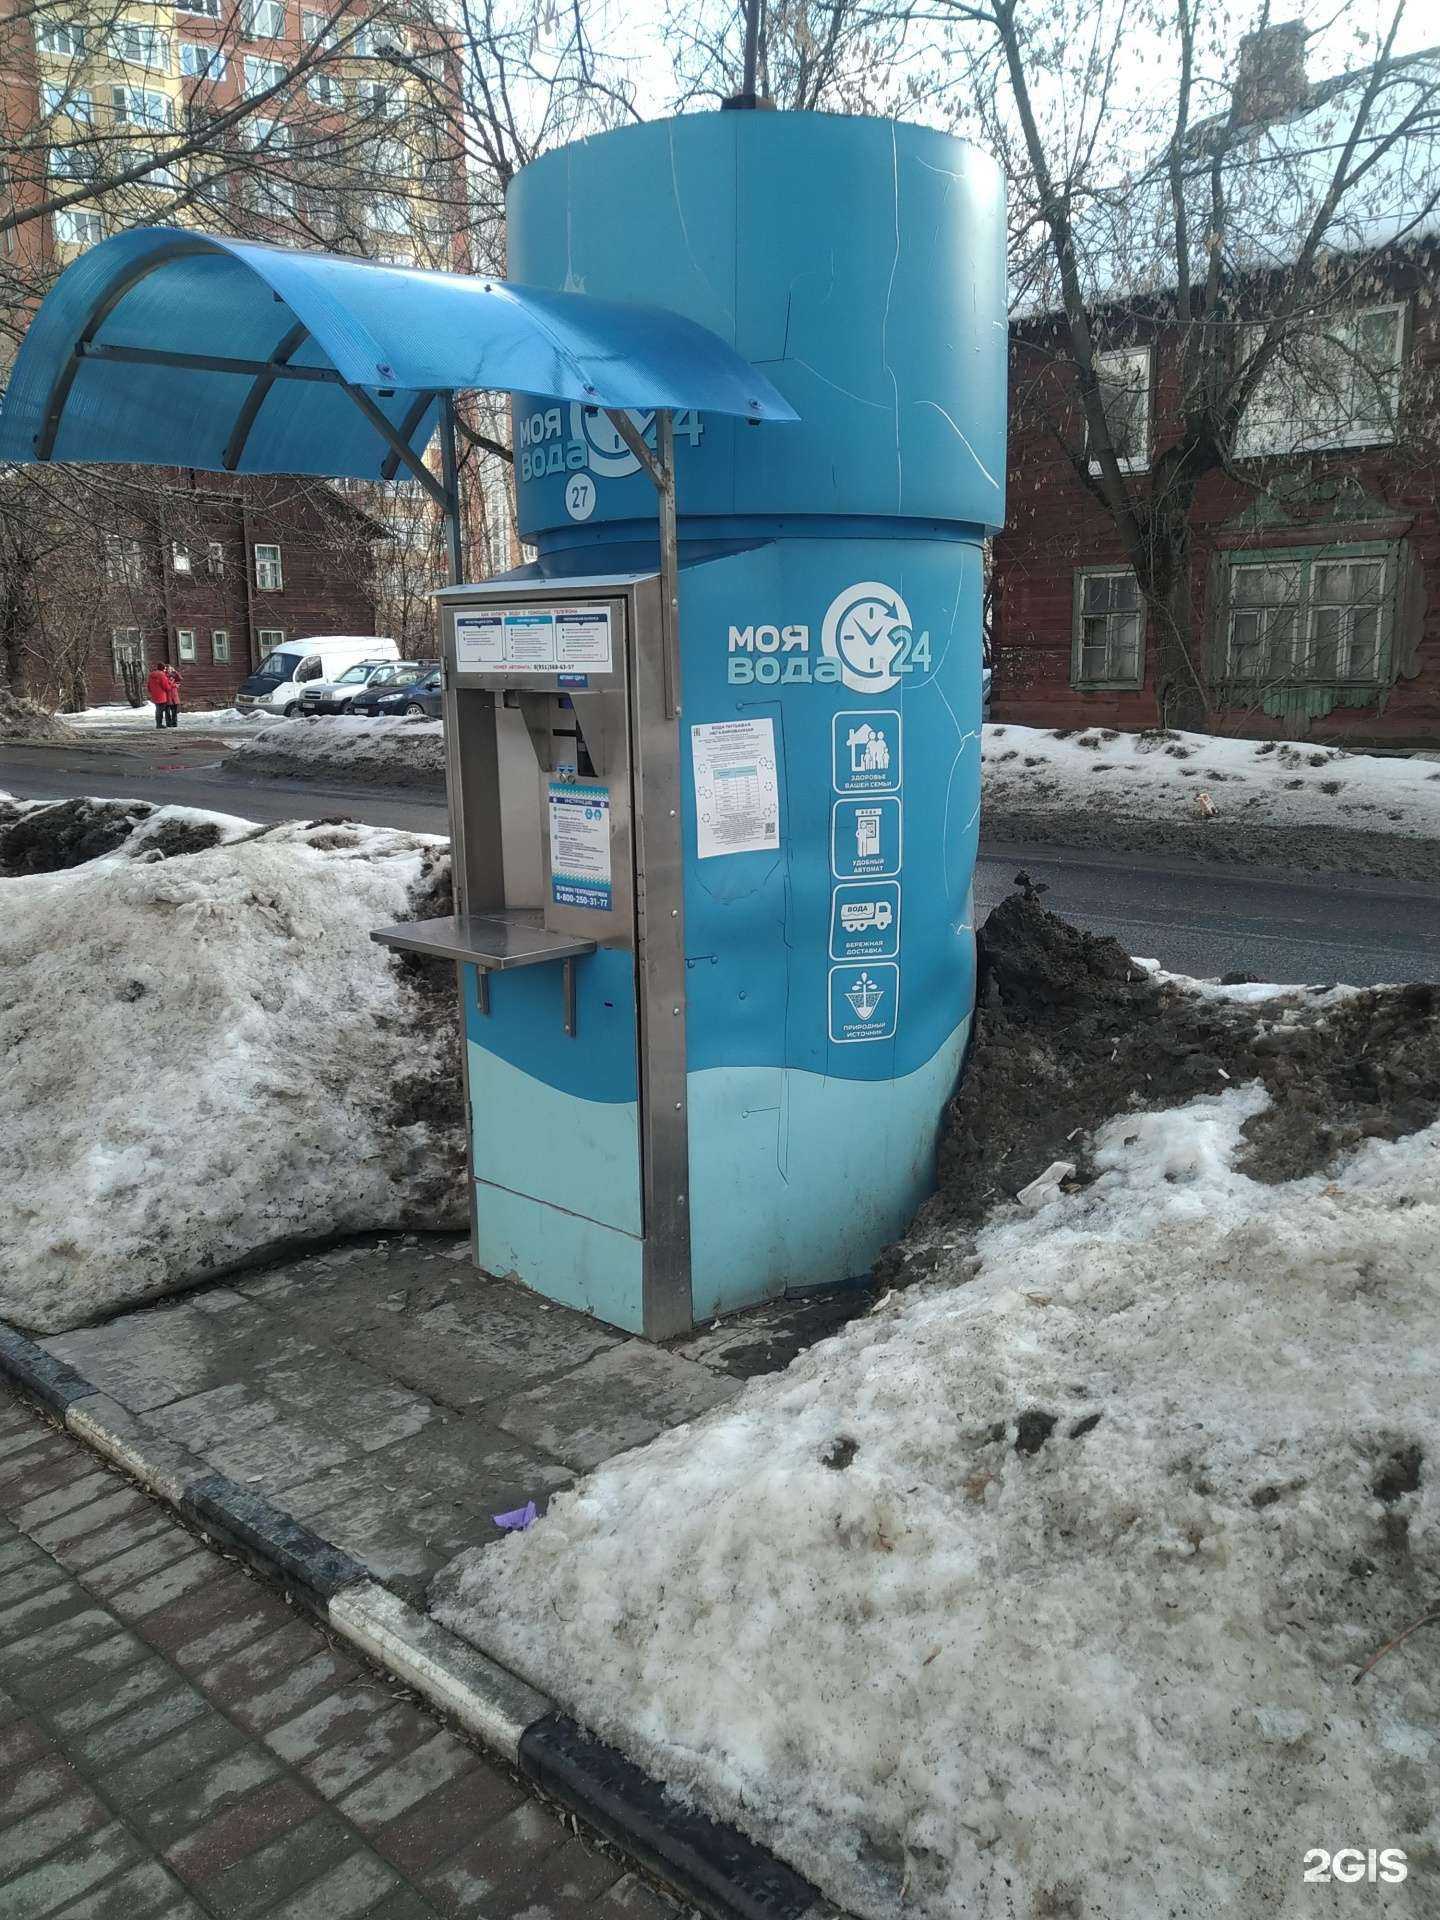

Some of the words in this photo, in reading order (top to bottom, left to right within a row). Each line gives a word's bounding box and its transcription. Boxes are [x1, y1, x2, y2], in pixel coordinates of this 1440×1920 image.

[519, 407, 562, 448] МОЯ
[571, 485, 589, 509] 27
[728, 624, 809, 653] МОЯ
[890, 629, 932, 674] 24
[852, 858, 885, 866] УДОБНЫЙ
[846, 940, 884, 948] БЕРЕЖНАЯ
[846, 947, 883, 955] ДОСТАВКА
[846, 1030, 882, 1038] ИСТОЧНИК
